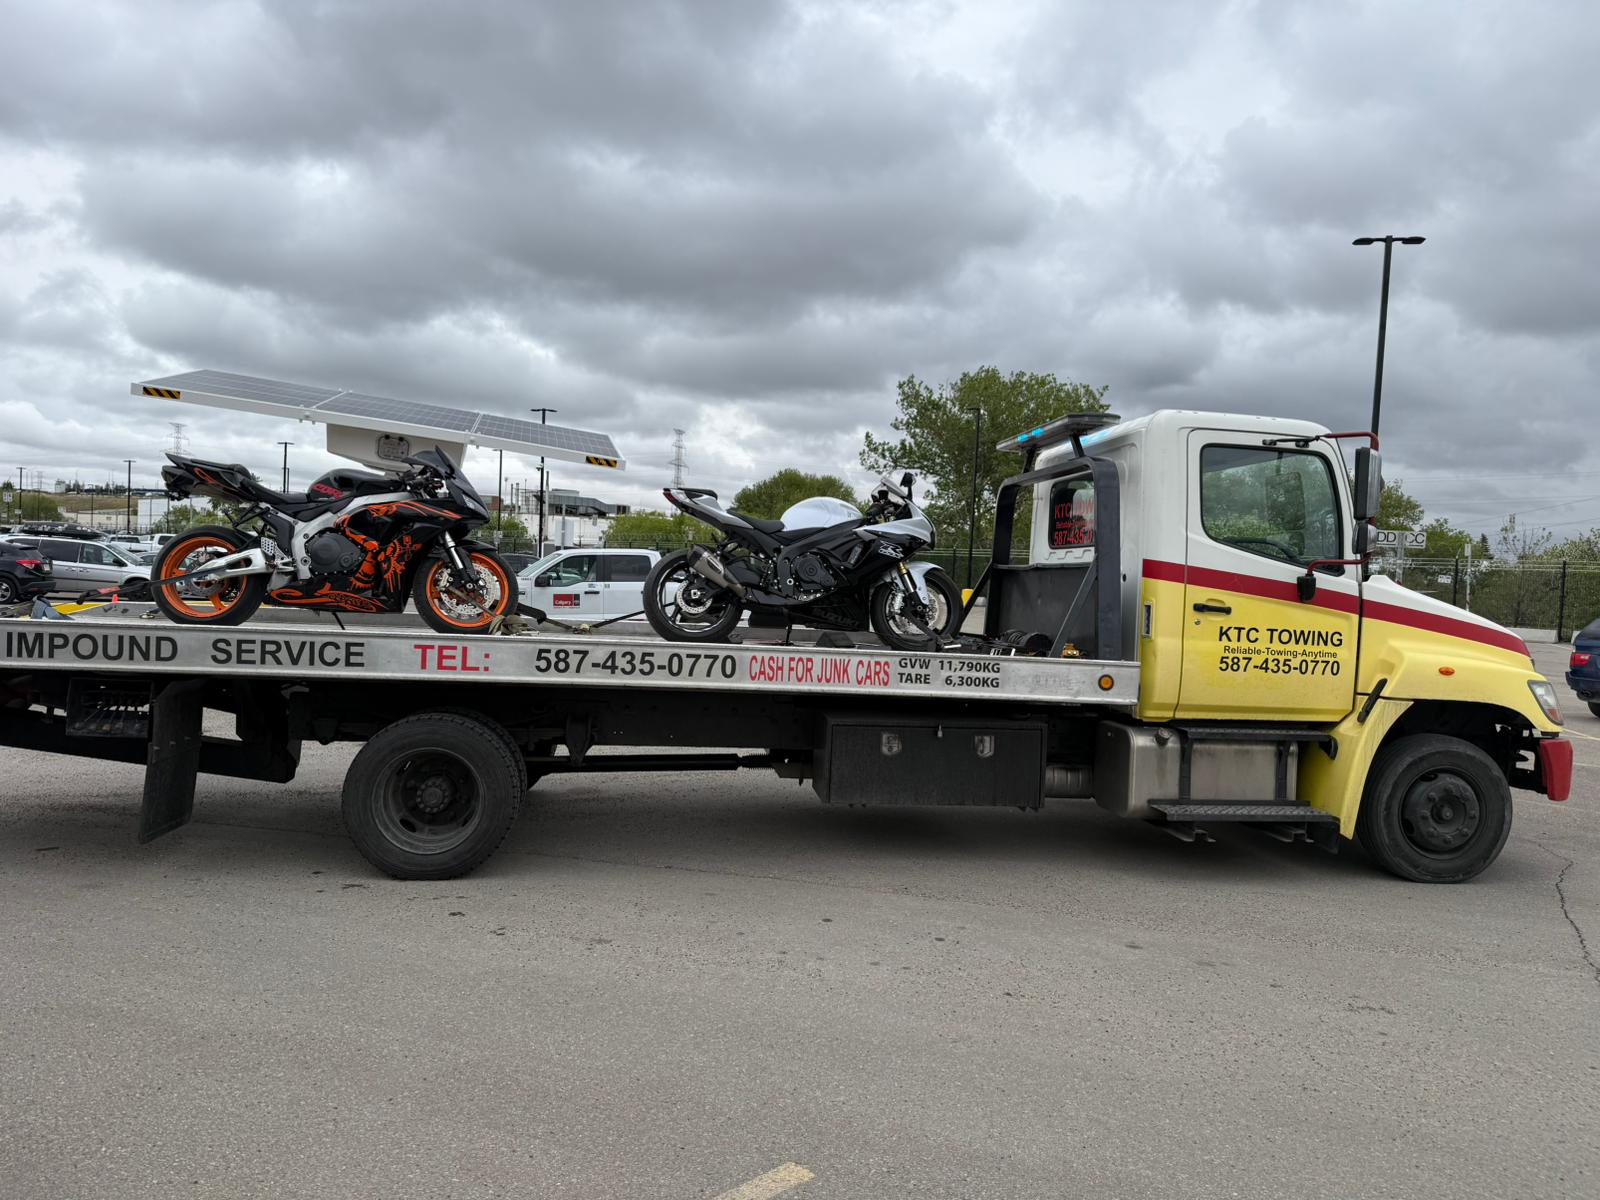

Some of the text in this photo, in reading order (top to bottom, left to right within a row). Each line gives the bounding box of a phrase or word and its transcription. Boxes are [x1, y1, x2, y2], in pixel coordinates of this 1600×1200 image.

[1055, 502, 1070, 519] KTC
[1055, 527, 1094, 545] 587-435-0
[1218, 626, 1343, 647] KTC TOWING
[6, 631, 737, 679] IMPOUND SERVICE TEL: 587-435-0770
[1223, 645, 1338, 660] Reliable-Towing-Anytime
[749, 655, 890, 686] CASH FOR JUNK CARS
[898, 657, 1001, 674] GVW 11,790KG
[1219, 656, 1341, 676] 587-435-0770
[897, 672, 1000, 688] TARE 6,300KG
